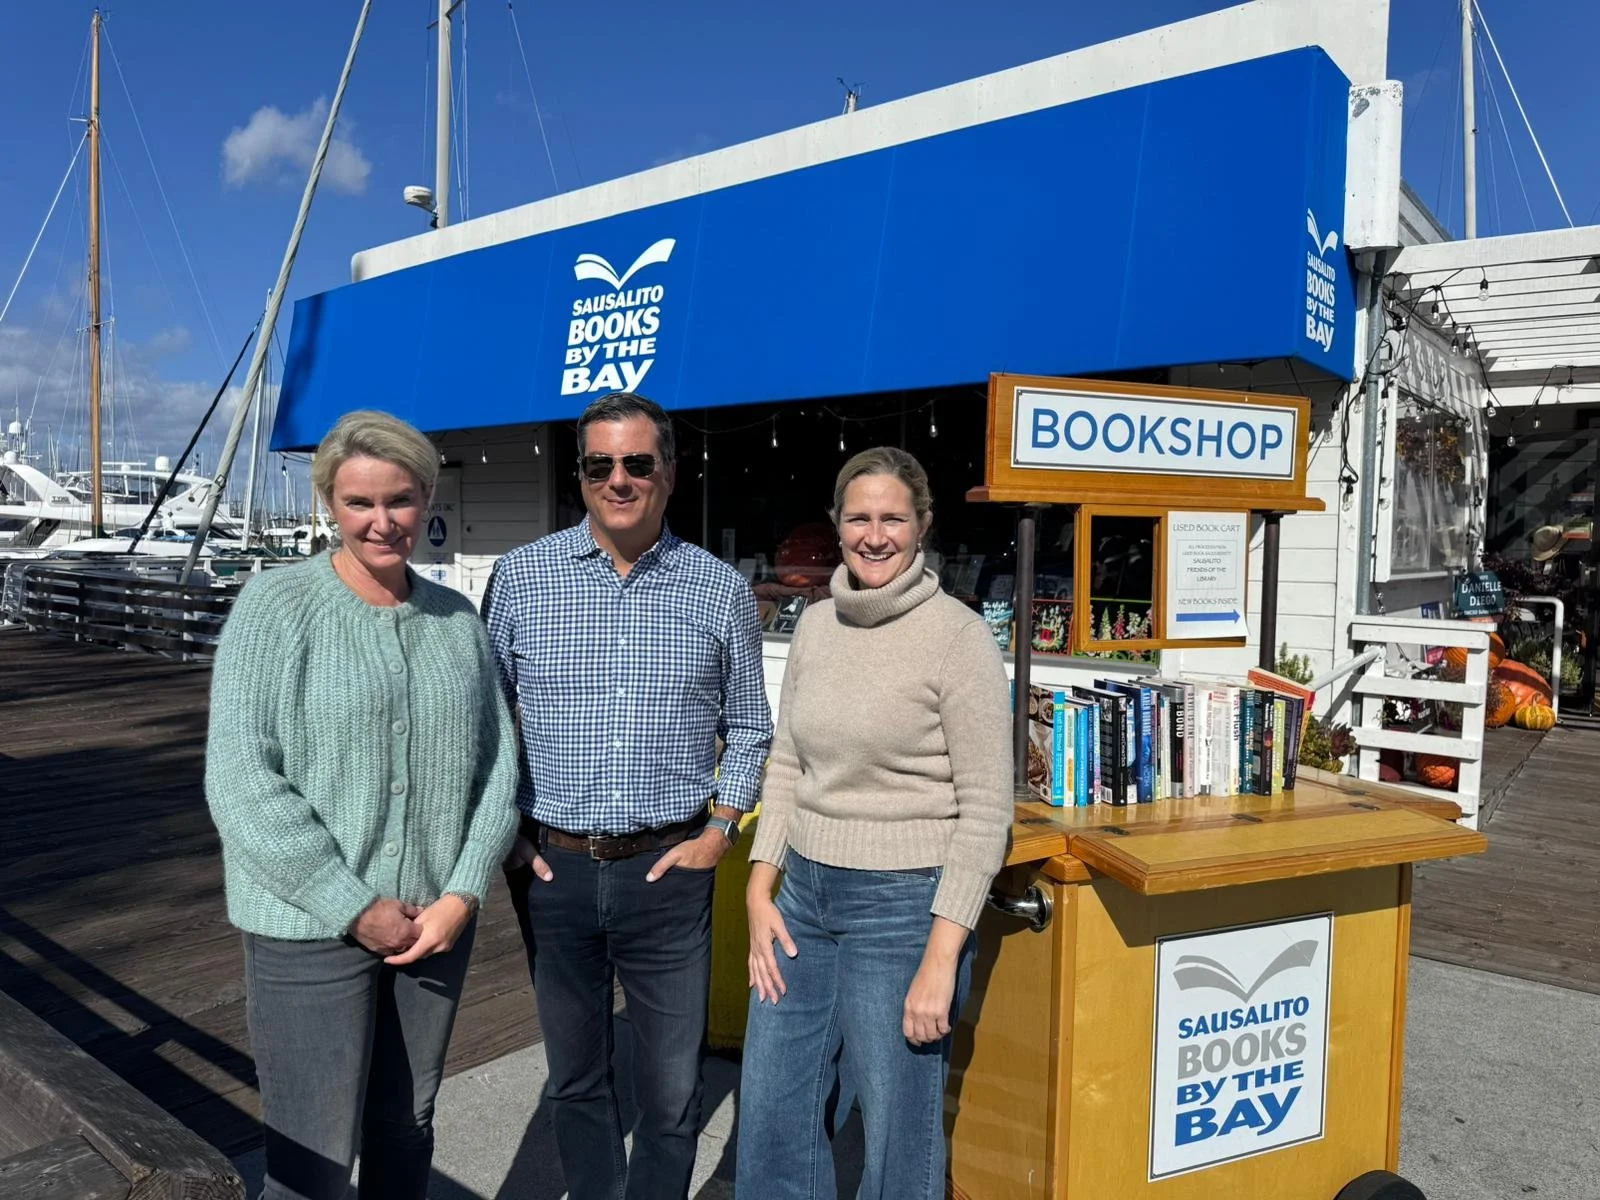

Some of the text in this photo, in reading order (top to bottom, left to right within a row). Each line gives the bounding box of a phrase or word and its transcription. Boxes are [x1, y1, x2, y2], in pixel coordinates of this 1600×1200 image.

[1307, 251, 1336, 282] SAUSALITO
[572, 285, 664, 316] SAUSALITO
[1306, 269, 1335, 307] BOOKS
[567, 306, 661, 346] BOOKS
[1318, 302, 1335, 324] THE
[602, 337, 657, 359] THE
[1031, 408, 1283, 461] BOOKSHOP
[1173, 524, 1241, 532] USED BOOK CART
[1193, 597, 1217, 605] BOOKS
[1218, 597, 1238, 605] INSIDE
[1461, 581, 1502, 594] DANIELLE
[1469, 594, 1497, 607] DIEGO
[1176, 710, 1184, 738] BOND
[1187, 714, 1194, 722] IS
[1233, 694, 1241, 741] Fat Flush
[1178, 996, 1310, 1039] SAUSALITO
[1177, 1022, 1307, 1080] BOOKS
[1232, 1060, 1304, 1092] THE
